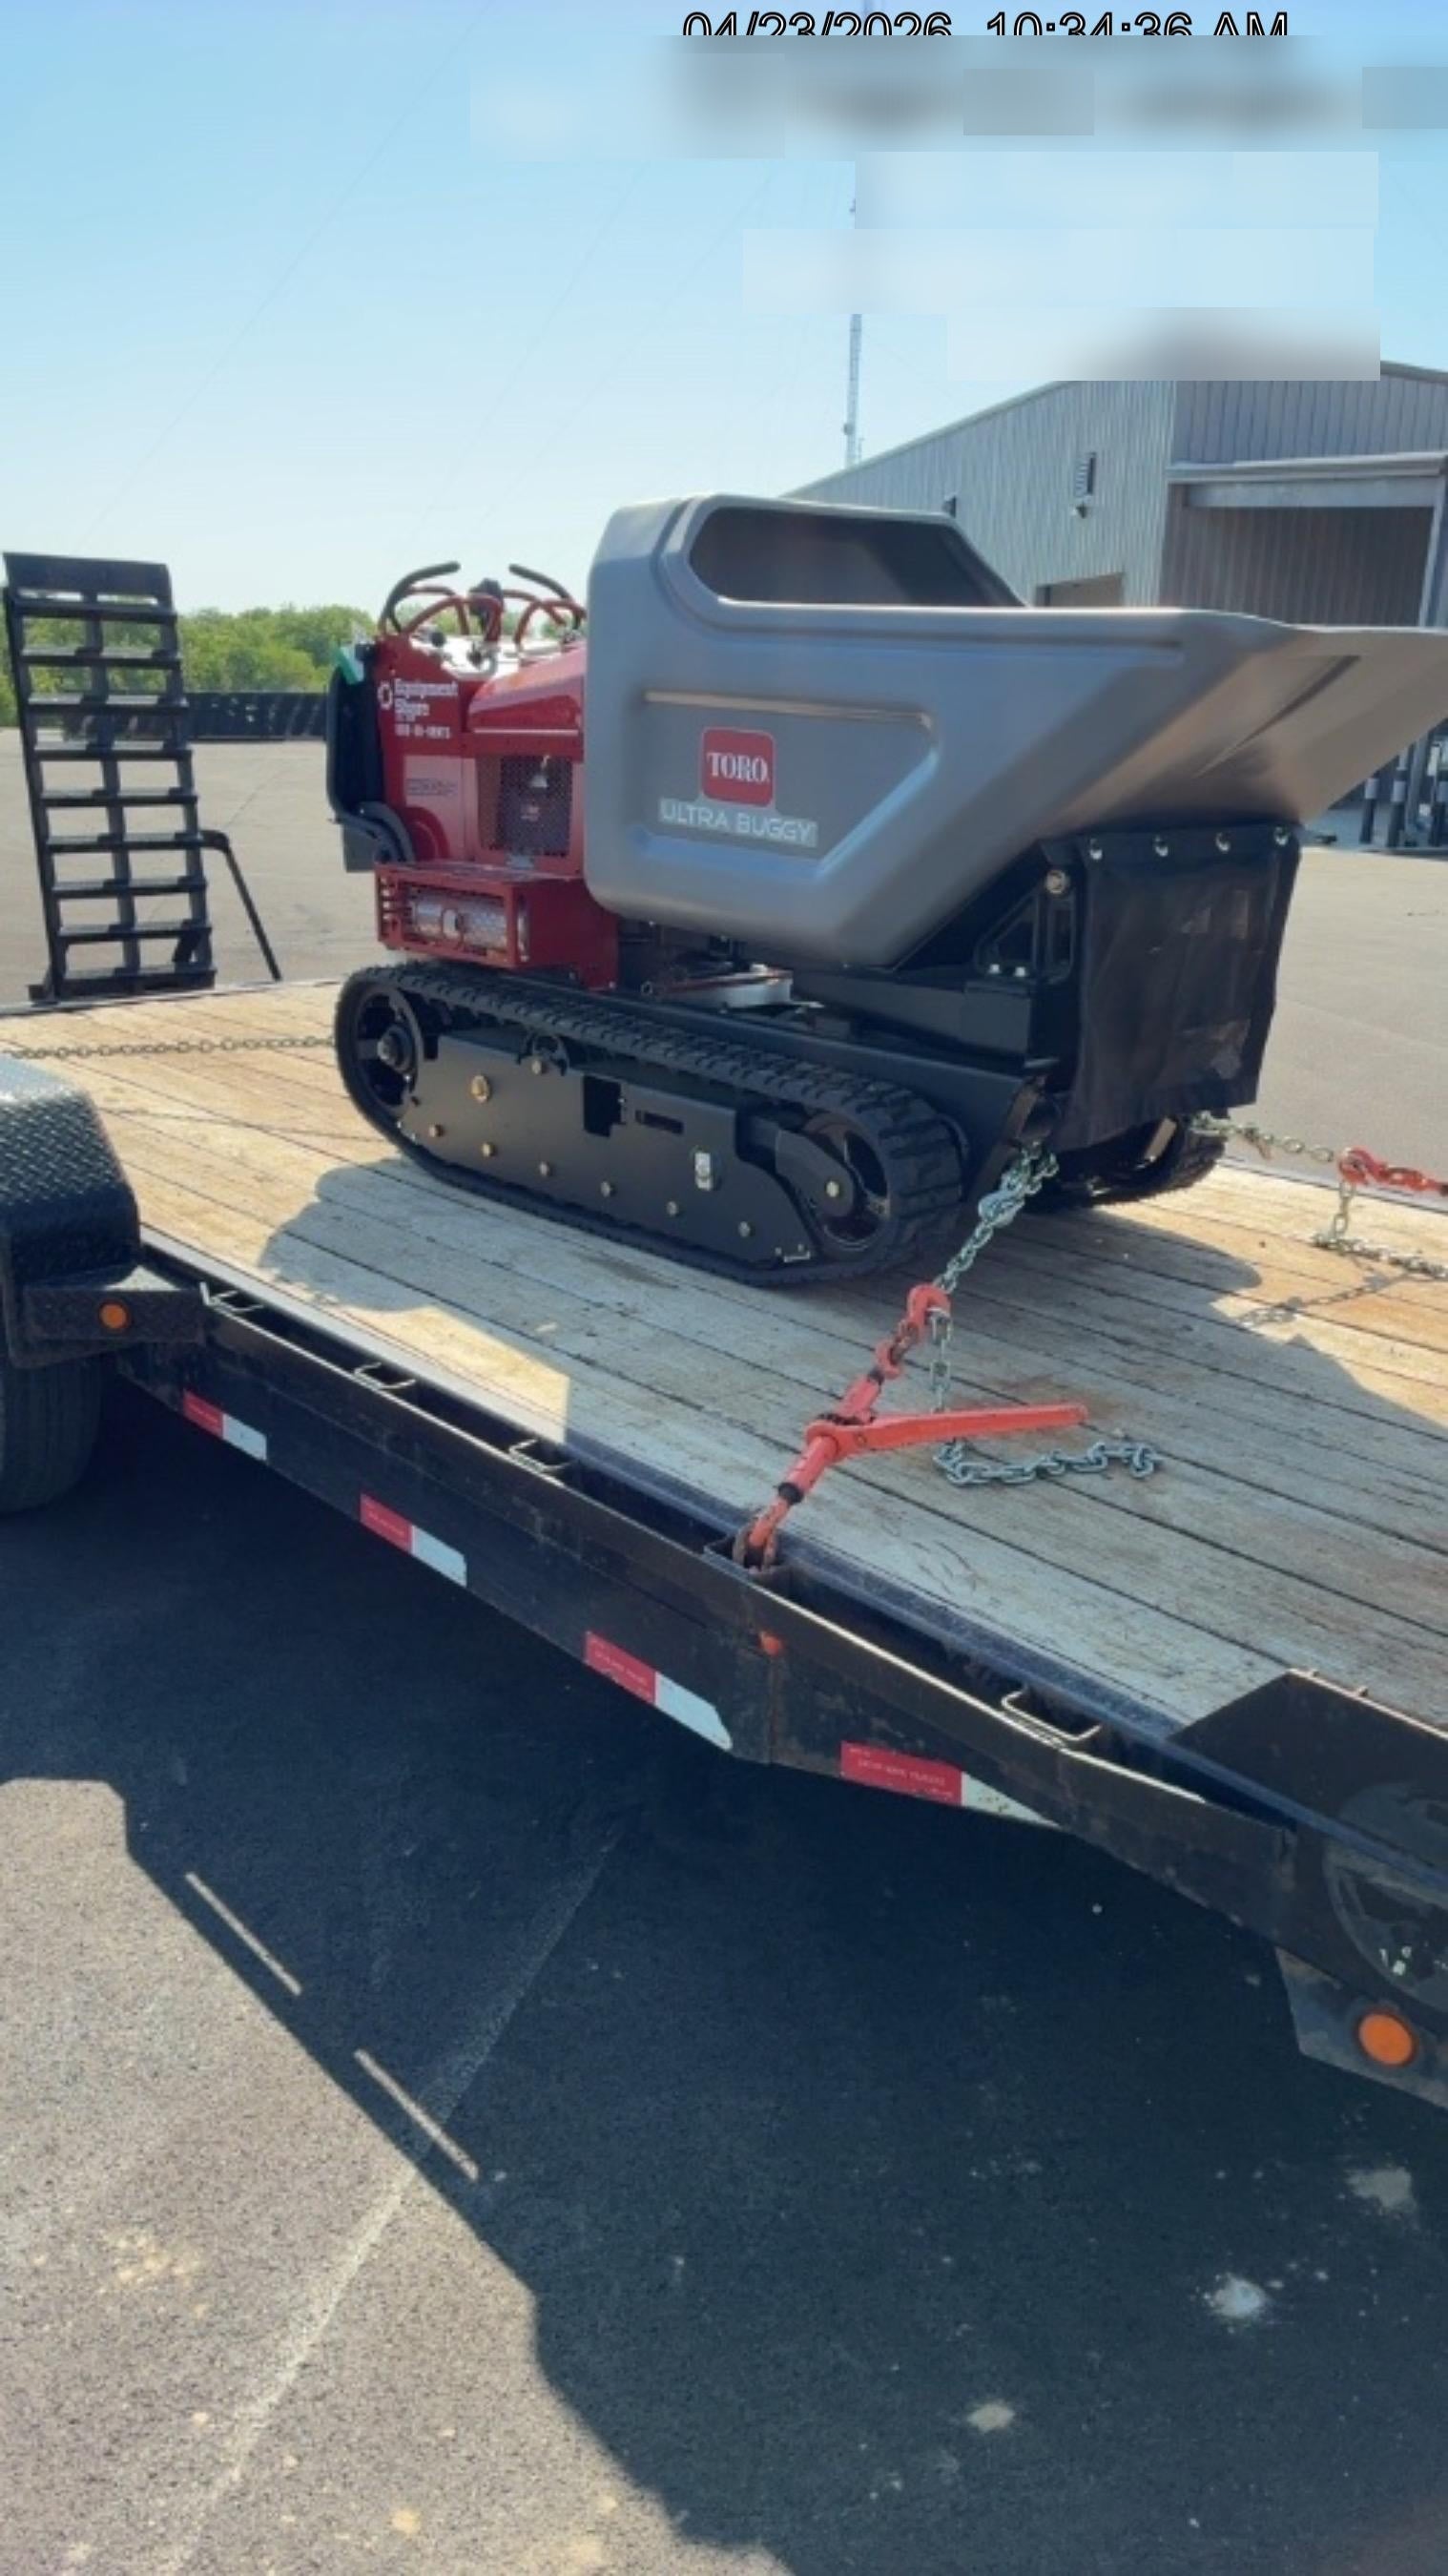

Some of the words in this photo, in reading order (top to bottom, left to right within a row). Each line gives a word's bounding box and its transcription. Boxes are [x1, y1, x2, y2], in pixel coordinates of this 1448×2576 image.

[706, 752, 769, 784] TORO
[660, 798, 729, 829] ULTRA
[736, 812, 812, 842] BUGGY
